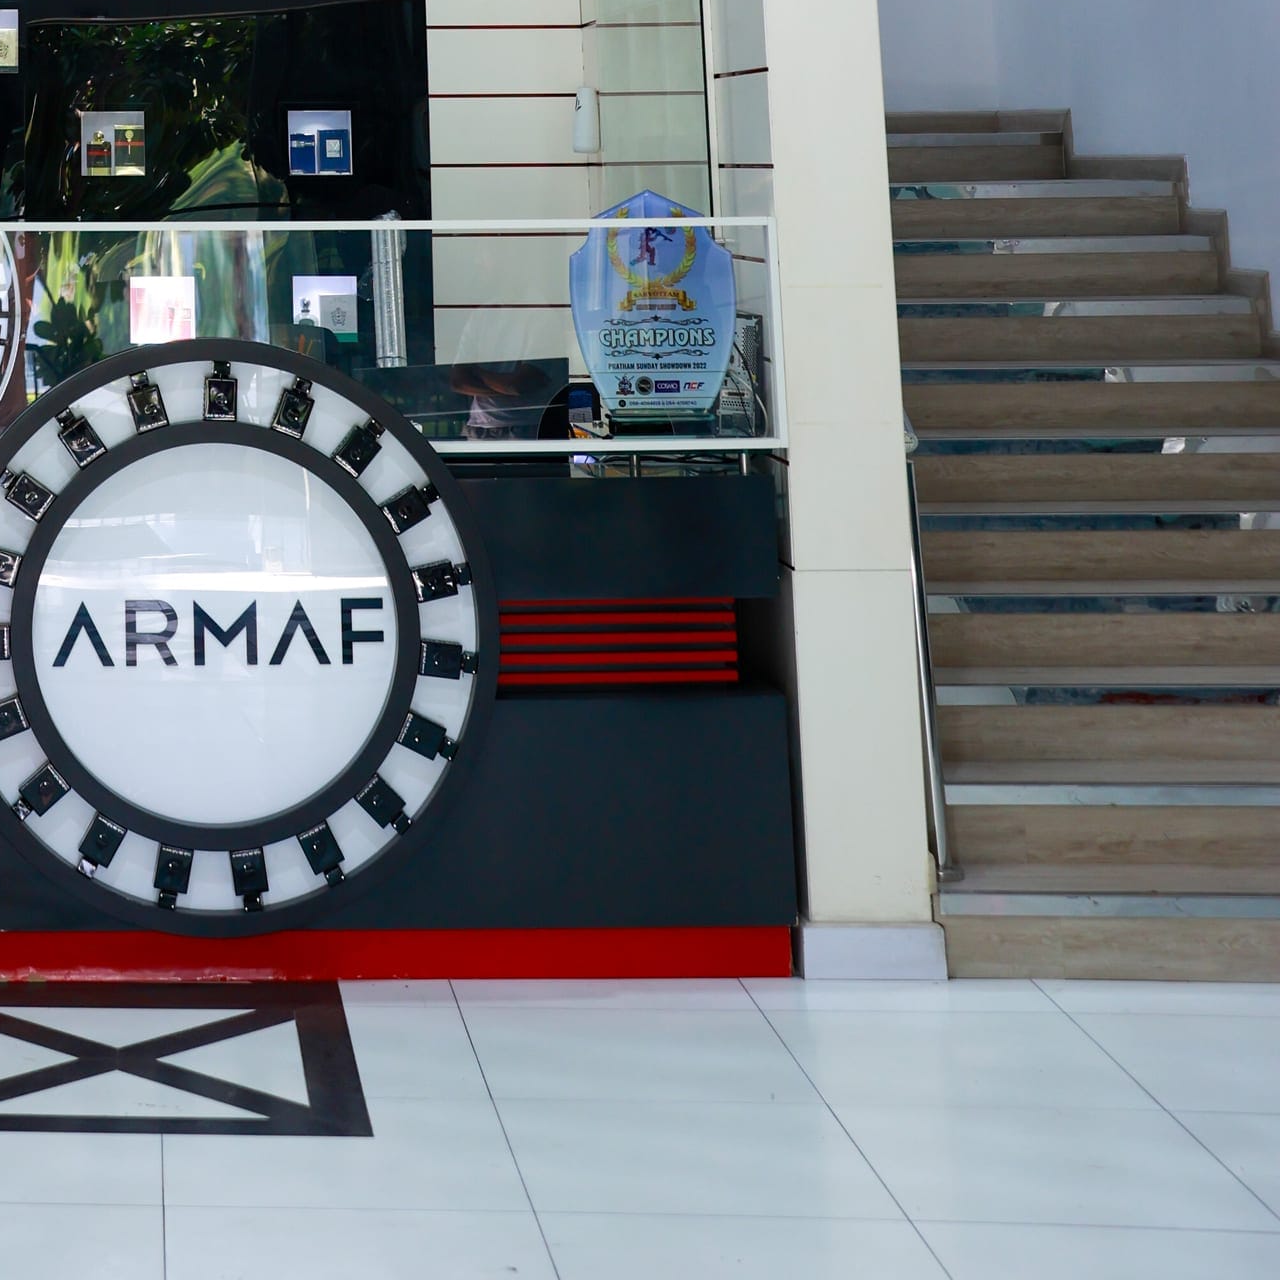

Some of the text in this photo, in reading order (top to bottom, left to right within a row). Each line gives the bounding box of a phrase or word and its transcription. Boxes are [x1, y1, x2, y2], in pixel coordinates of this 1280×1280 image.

[599, 327, 716, 349] CHAMPIONS
[636, 362, 658, 370] SUNDAY
[660, 362, 692, 370] SHOWDOWN
[52, 597, 385, 667] ARMAF
